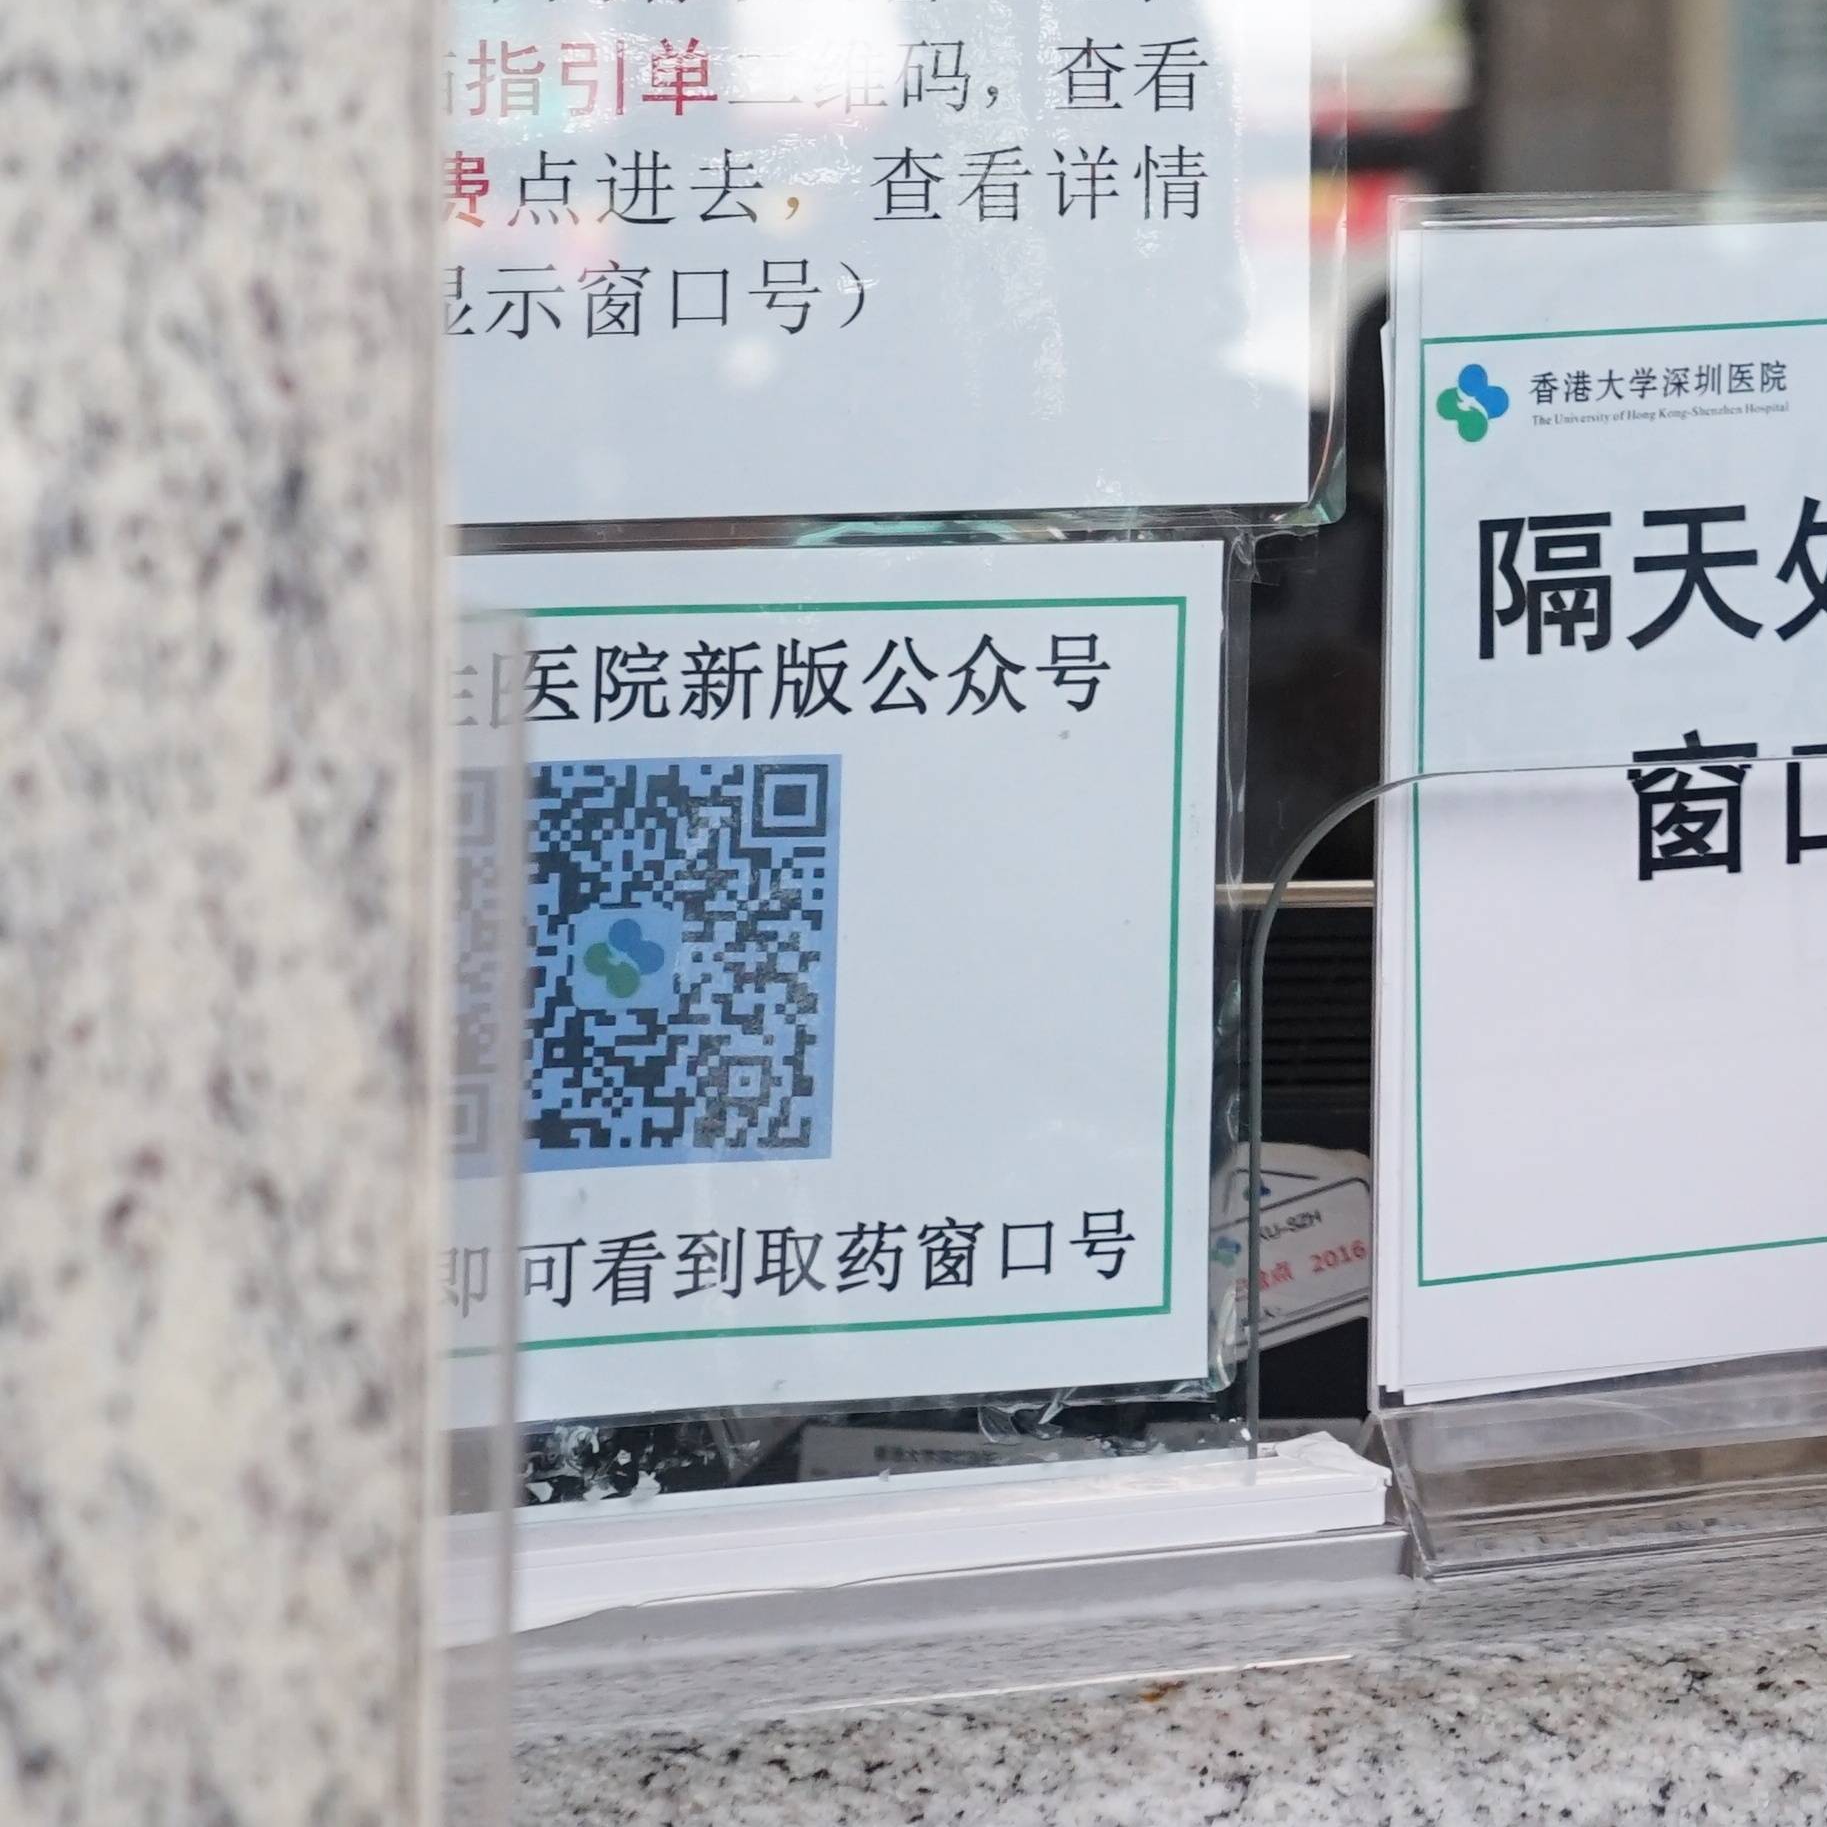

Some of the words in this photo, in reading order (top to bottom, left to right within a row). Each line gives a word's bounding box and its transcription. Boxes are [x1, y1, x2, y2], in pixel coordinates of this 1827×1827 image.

[1529, 360, 1788, 406] 香港大学深圳医院
[1532, 413, 1552, 427] The
[1554, 410, 1611, 426] University
[1613, 408, 1626, 421] of
[1310, 1239, 1368, 1275] 2016
